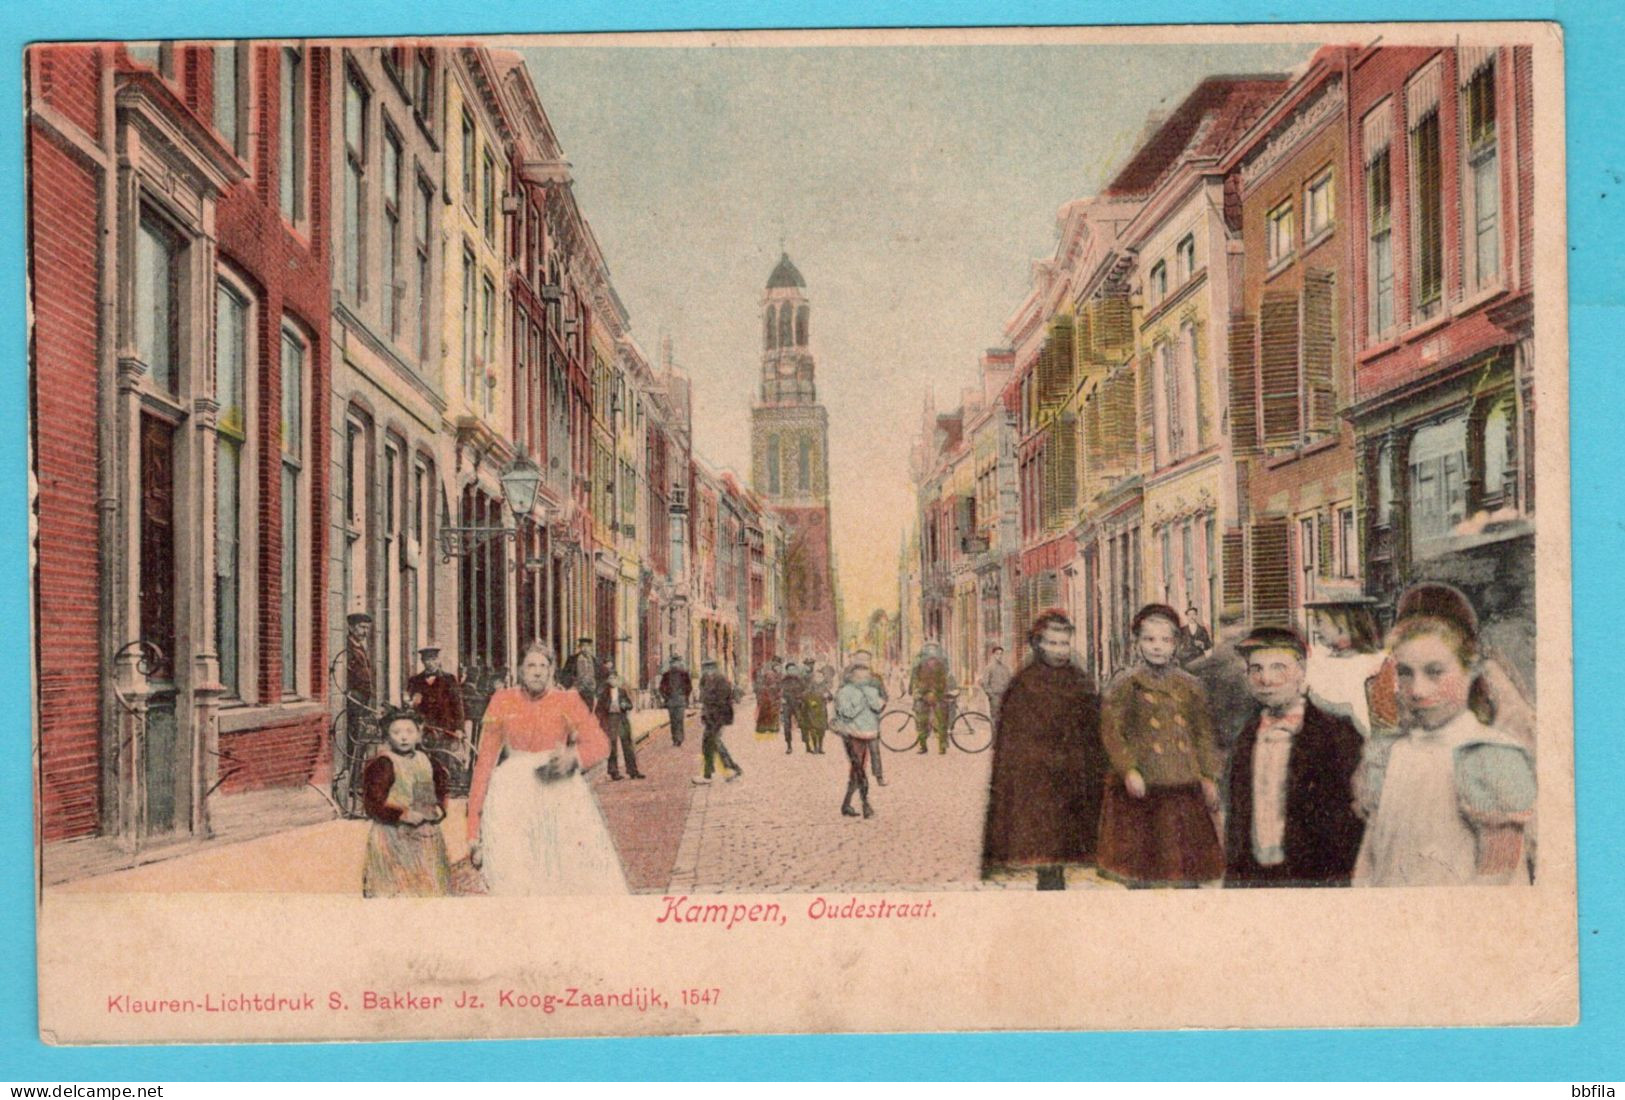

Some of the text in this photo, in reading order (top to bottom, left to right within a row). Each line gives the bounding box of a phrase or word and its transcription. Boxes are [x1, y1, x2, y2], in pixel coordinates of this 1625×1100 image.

[655, 895, 938, 930] Kampen, Oudestraat.
[107, 987, 721, 1014] Kleuren-Lichtdruk S. Bakker Jz. Koog-Zaandijk, 1547
